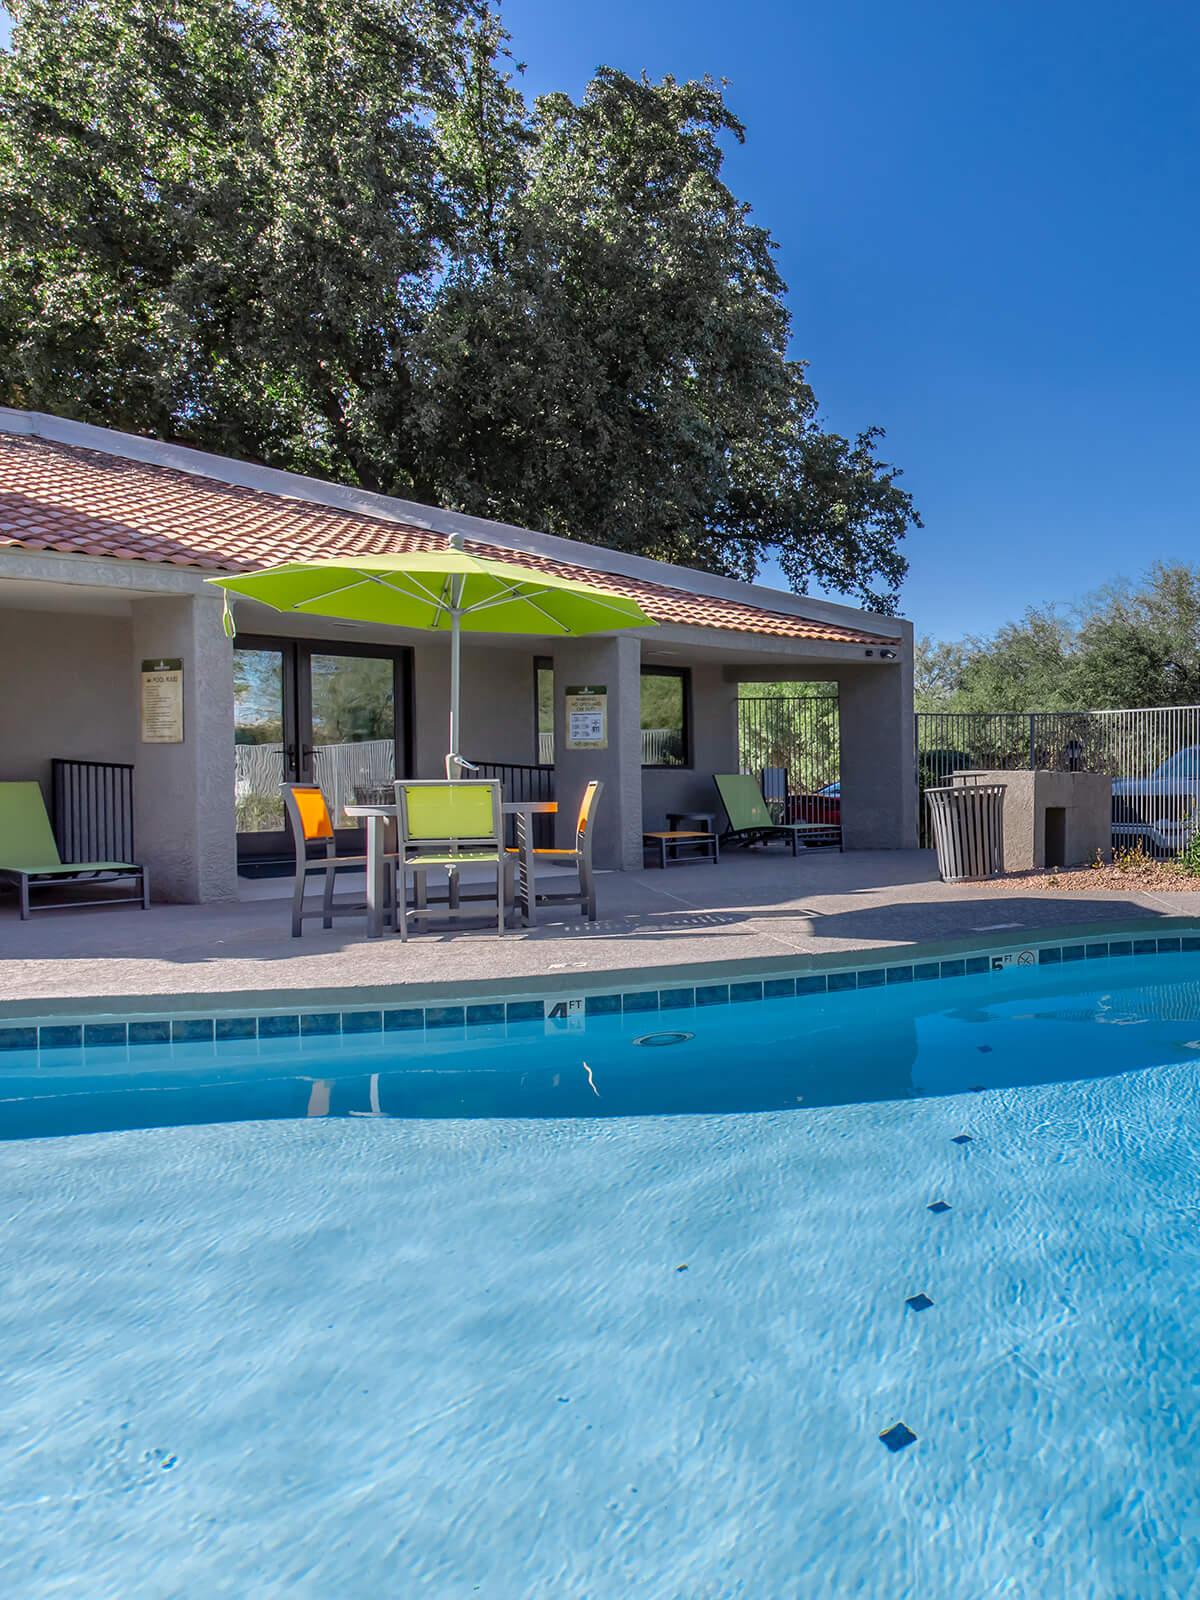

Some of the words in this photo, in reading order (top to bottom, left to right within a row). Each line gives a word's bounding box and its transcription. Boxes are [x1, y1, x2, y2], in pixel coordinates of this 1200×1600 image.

[991, 957, 1003, 971] 5
[1004, 954, 1012, 962] FT
[569, 1000, 582, 1009] FT
